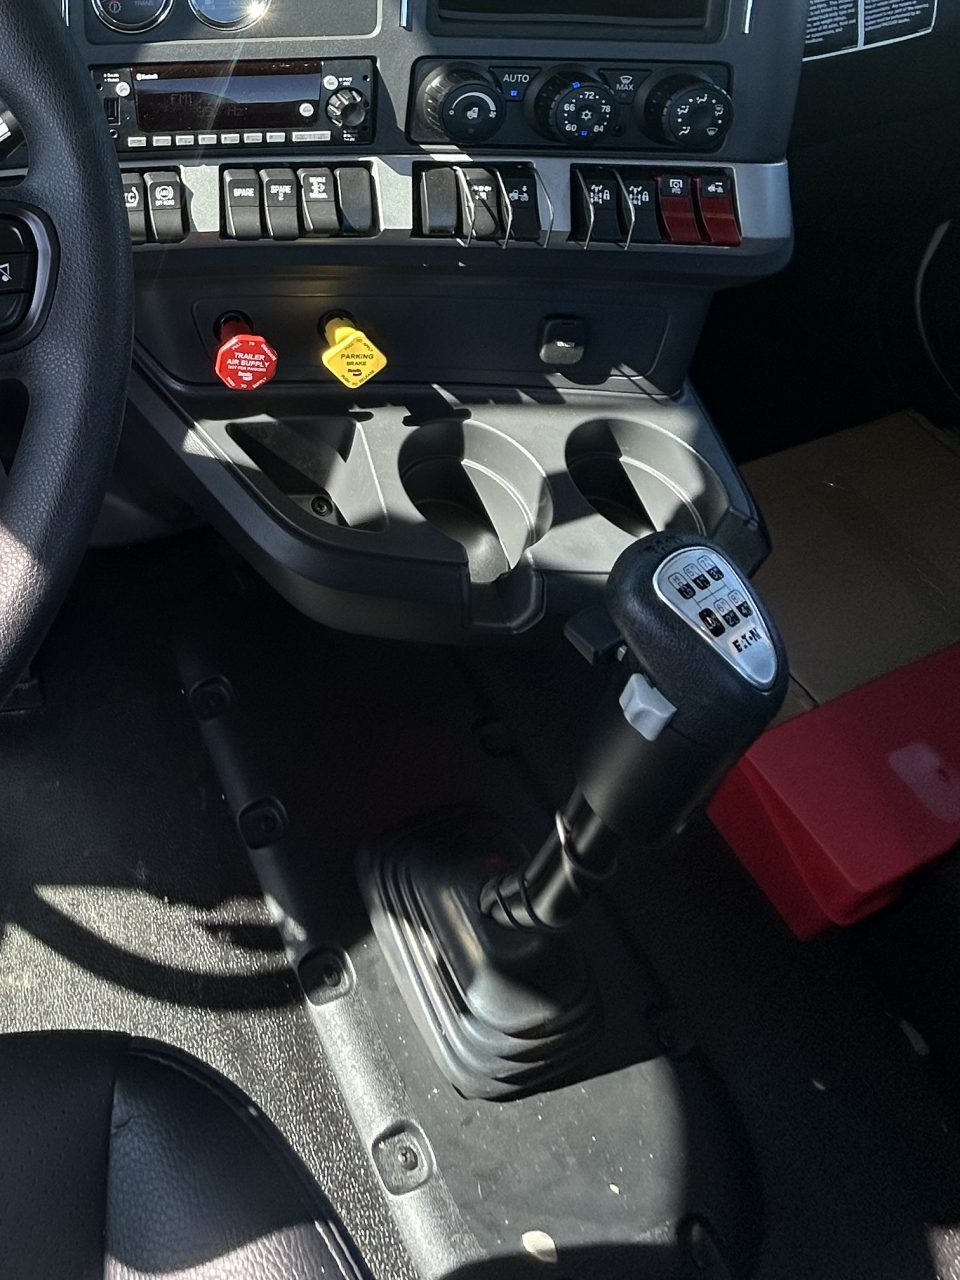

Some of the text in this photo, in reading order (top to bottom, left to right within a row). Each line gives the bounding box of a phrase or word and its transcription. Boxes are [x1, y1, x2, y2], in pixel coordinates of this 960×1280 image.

[503, 74, 530, 83] AUTO
[584, 91, 595, 99] 72
[564, 103, 575, 111] 66
[601, 105, 611, 113] 78
[233, 188, 254, 197] SPARE
[270, 185, 292, 194] SPARE
[234, 352, 266, 361] TRAILER
[241, 360, 270, 368] SUPPLY
